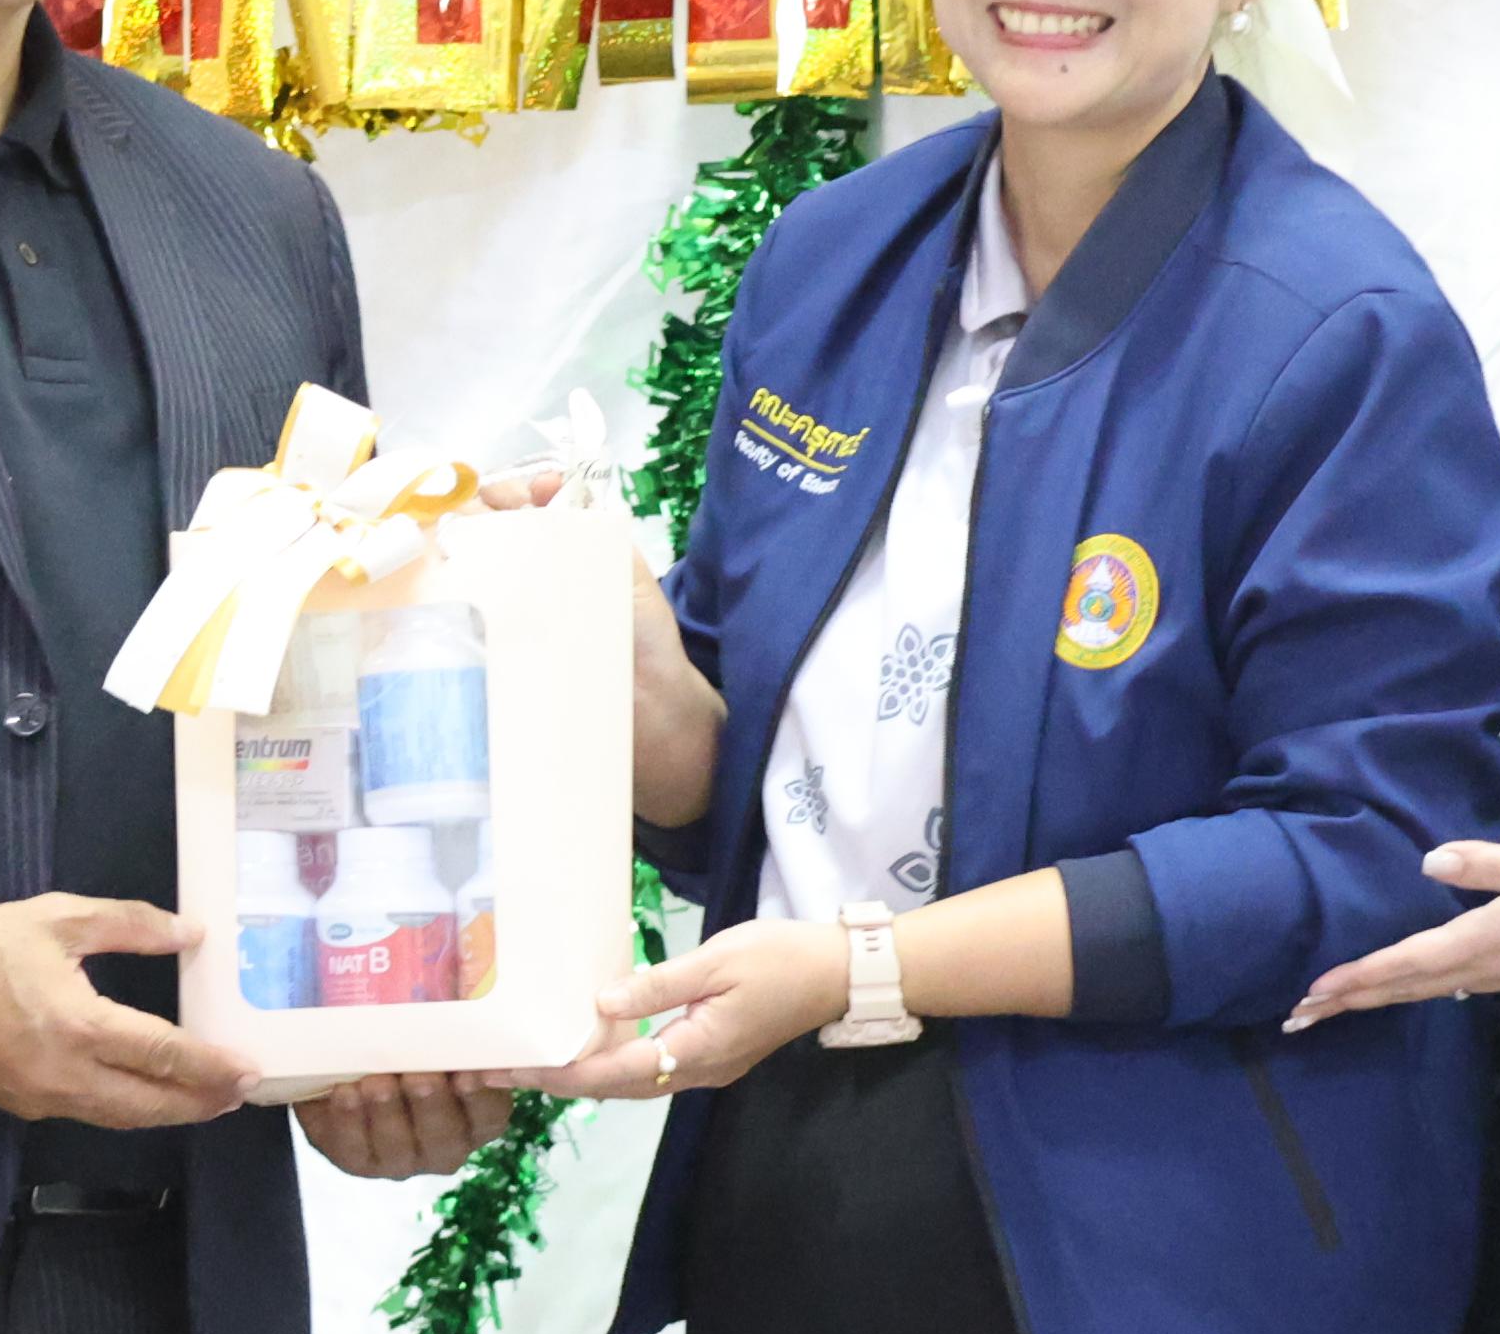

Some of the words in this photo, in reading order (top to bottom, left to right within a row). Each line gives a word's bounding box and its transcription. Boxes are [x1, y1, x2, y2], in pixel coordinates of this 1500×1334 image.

[776, 463, 805, 482] of
[235, 735, 312, 759] entrum
[328, 954, 368, 975] NAT
[369, 946, 391, 974] B
